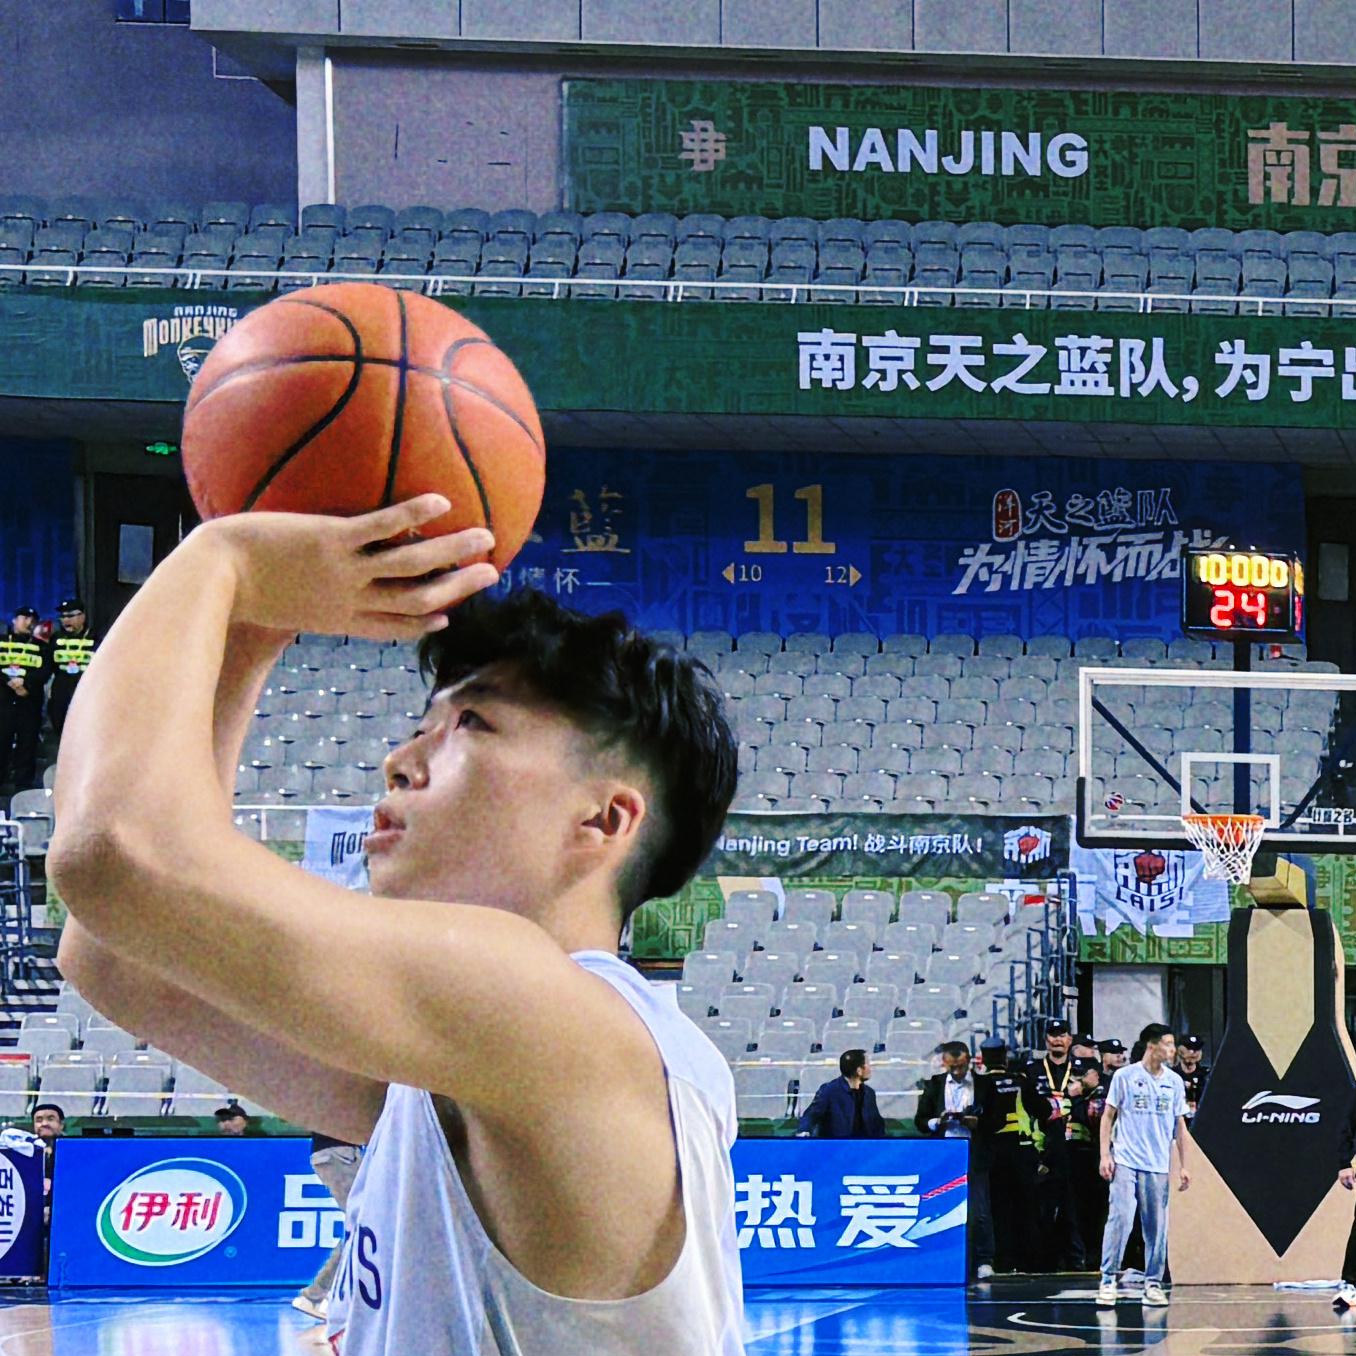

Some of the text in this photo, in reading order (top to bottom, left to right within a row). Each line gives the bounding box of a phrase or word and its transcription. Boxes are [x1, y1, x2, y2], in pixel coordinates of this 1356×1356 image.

[808, 126, 1089, 178] NANJING
[744, 484, 836, 553] 11
[738, 566, 848, 584] 10 12
[1211, 590, 1265, 626] 24
[799, 834, 857, 853] Team!
[1241, 1112, 1320, 1124] LI-NING
[119, 1191, 223, 1232] 伊利
[735, 1174, 921, 1248] 热爱
